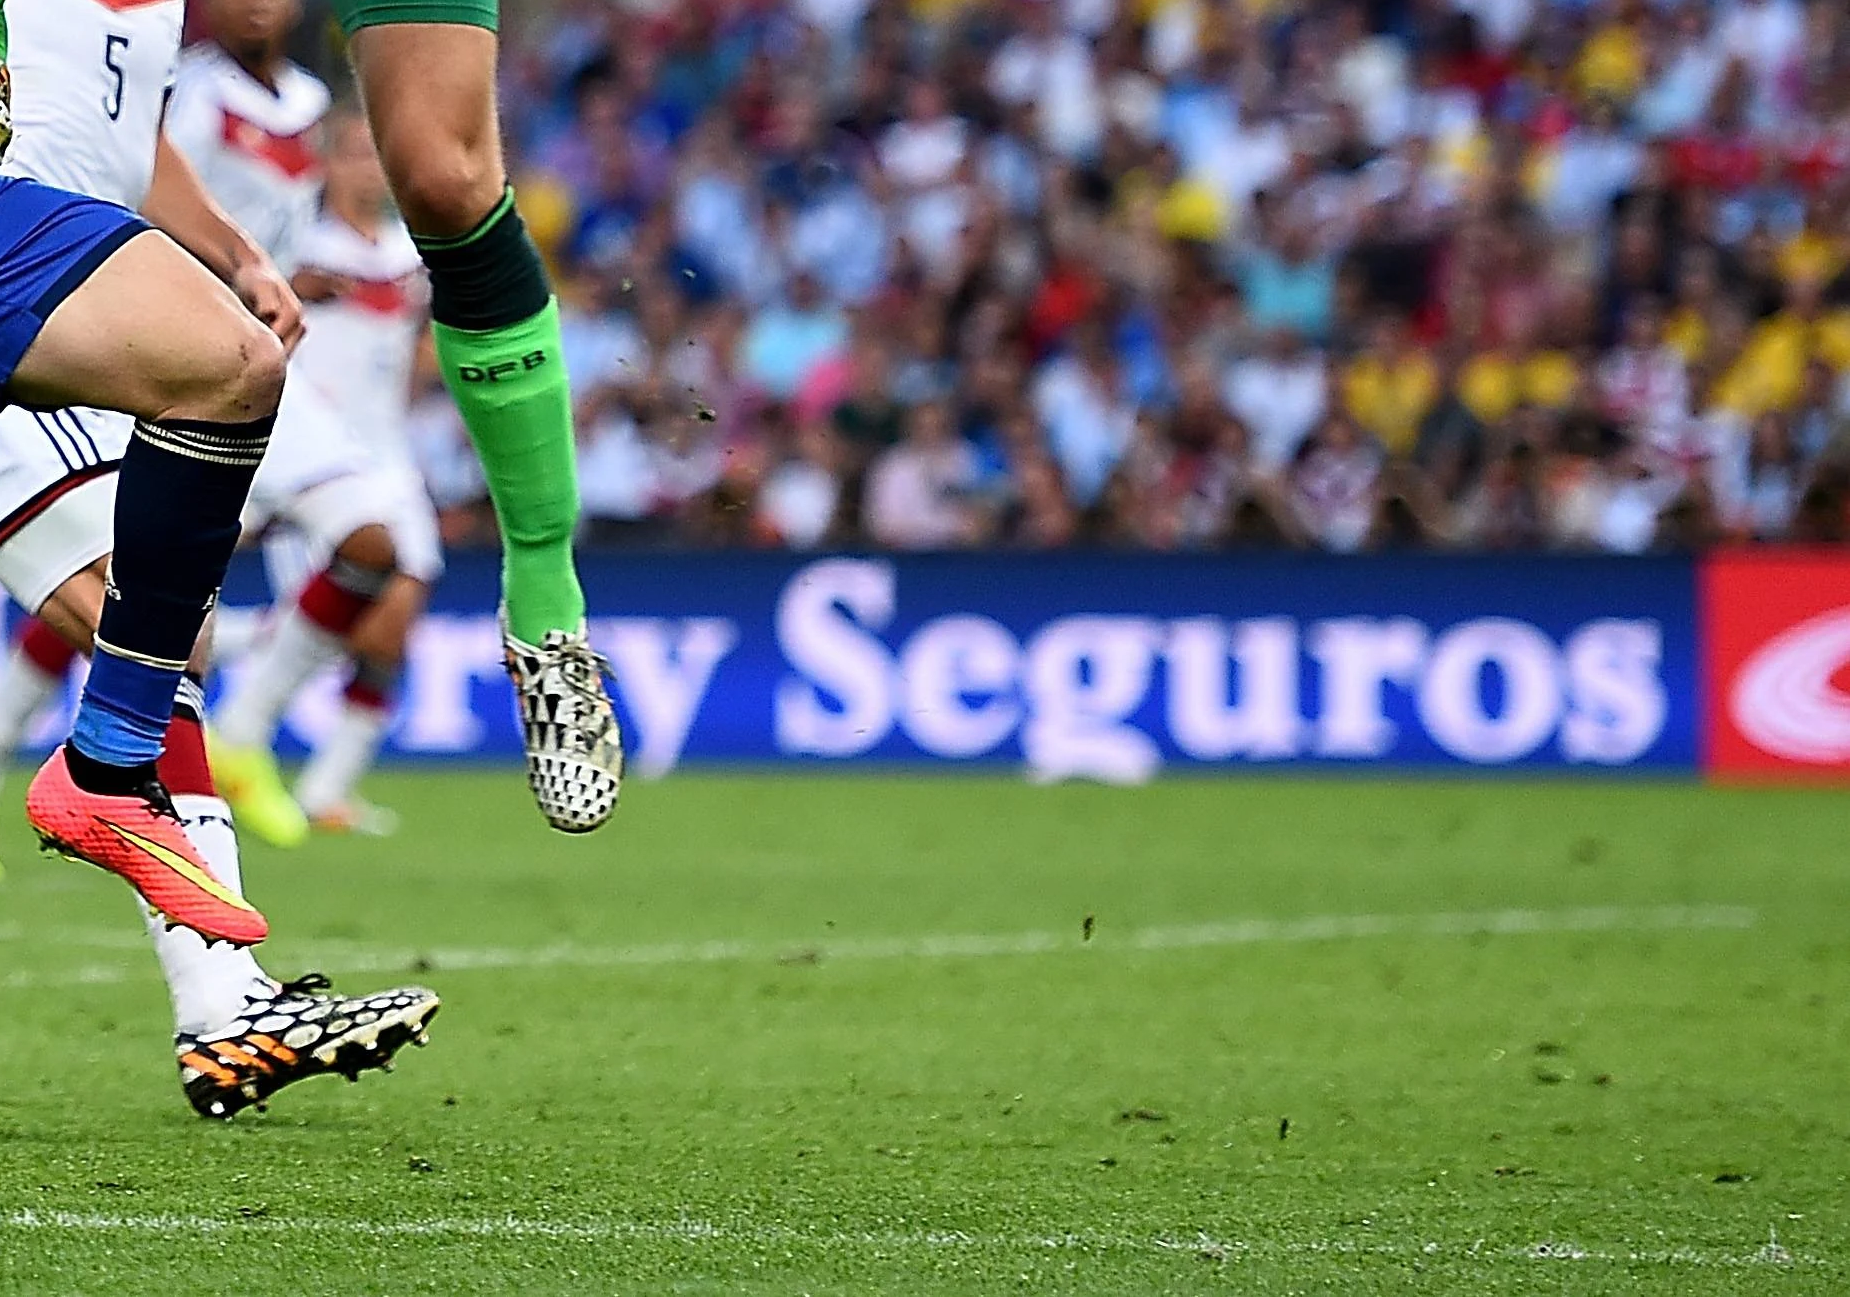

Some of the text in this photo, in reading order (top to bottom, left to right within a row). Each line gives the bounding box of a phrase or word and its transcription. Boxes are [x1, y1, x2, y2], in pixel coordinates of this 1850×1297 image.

[103, 34, 128, 121] 5
[458, 349, 546, 383] DFB
[772, 555, 1668, 785] Seguros
